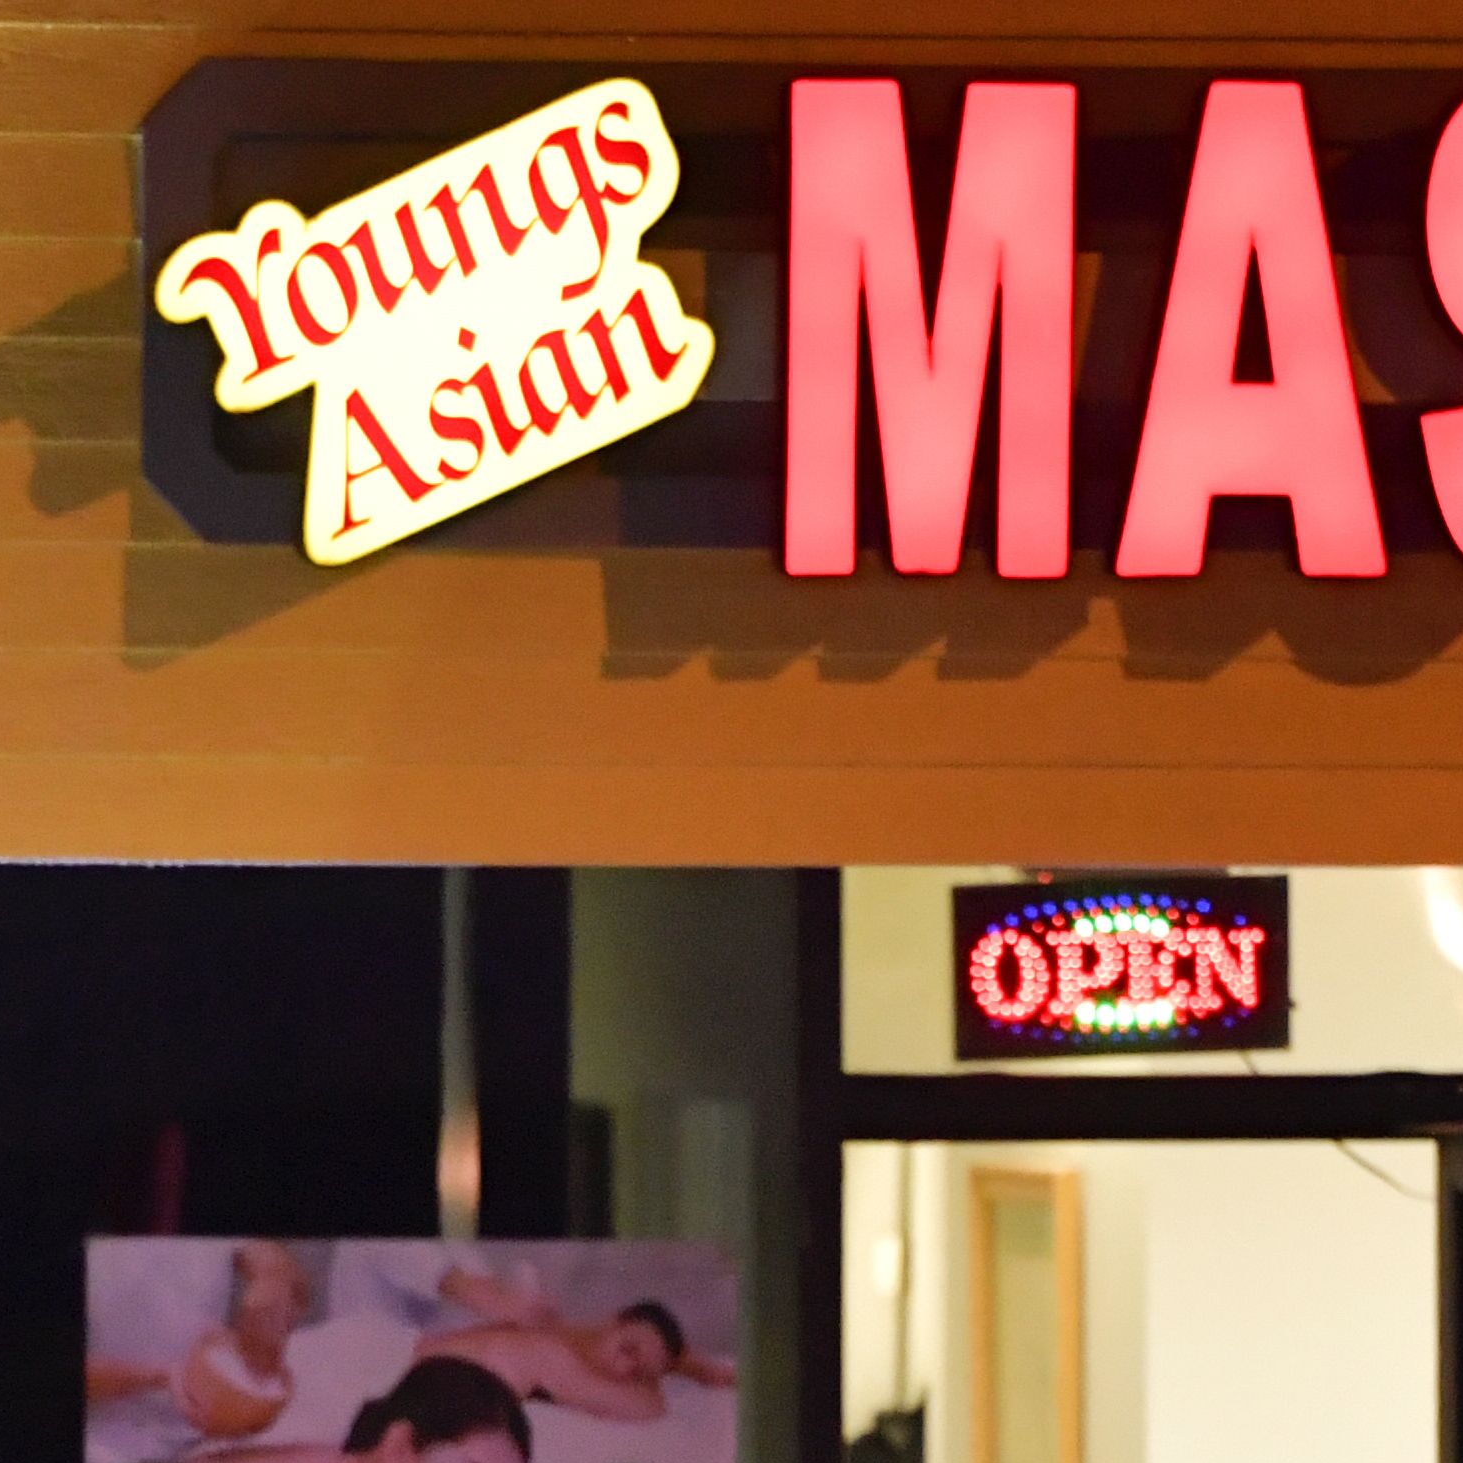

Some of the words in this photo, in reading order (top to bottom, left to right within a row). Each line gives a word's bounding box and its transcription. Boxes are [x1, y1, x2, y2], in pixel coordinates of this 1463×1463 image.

[178, 100, 651, 384] Youngs
[330, 288, 688, 541] Asian
[969, 926, 1266, 1021] OPEN
